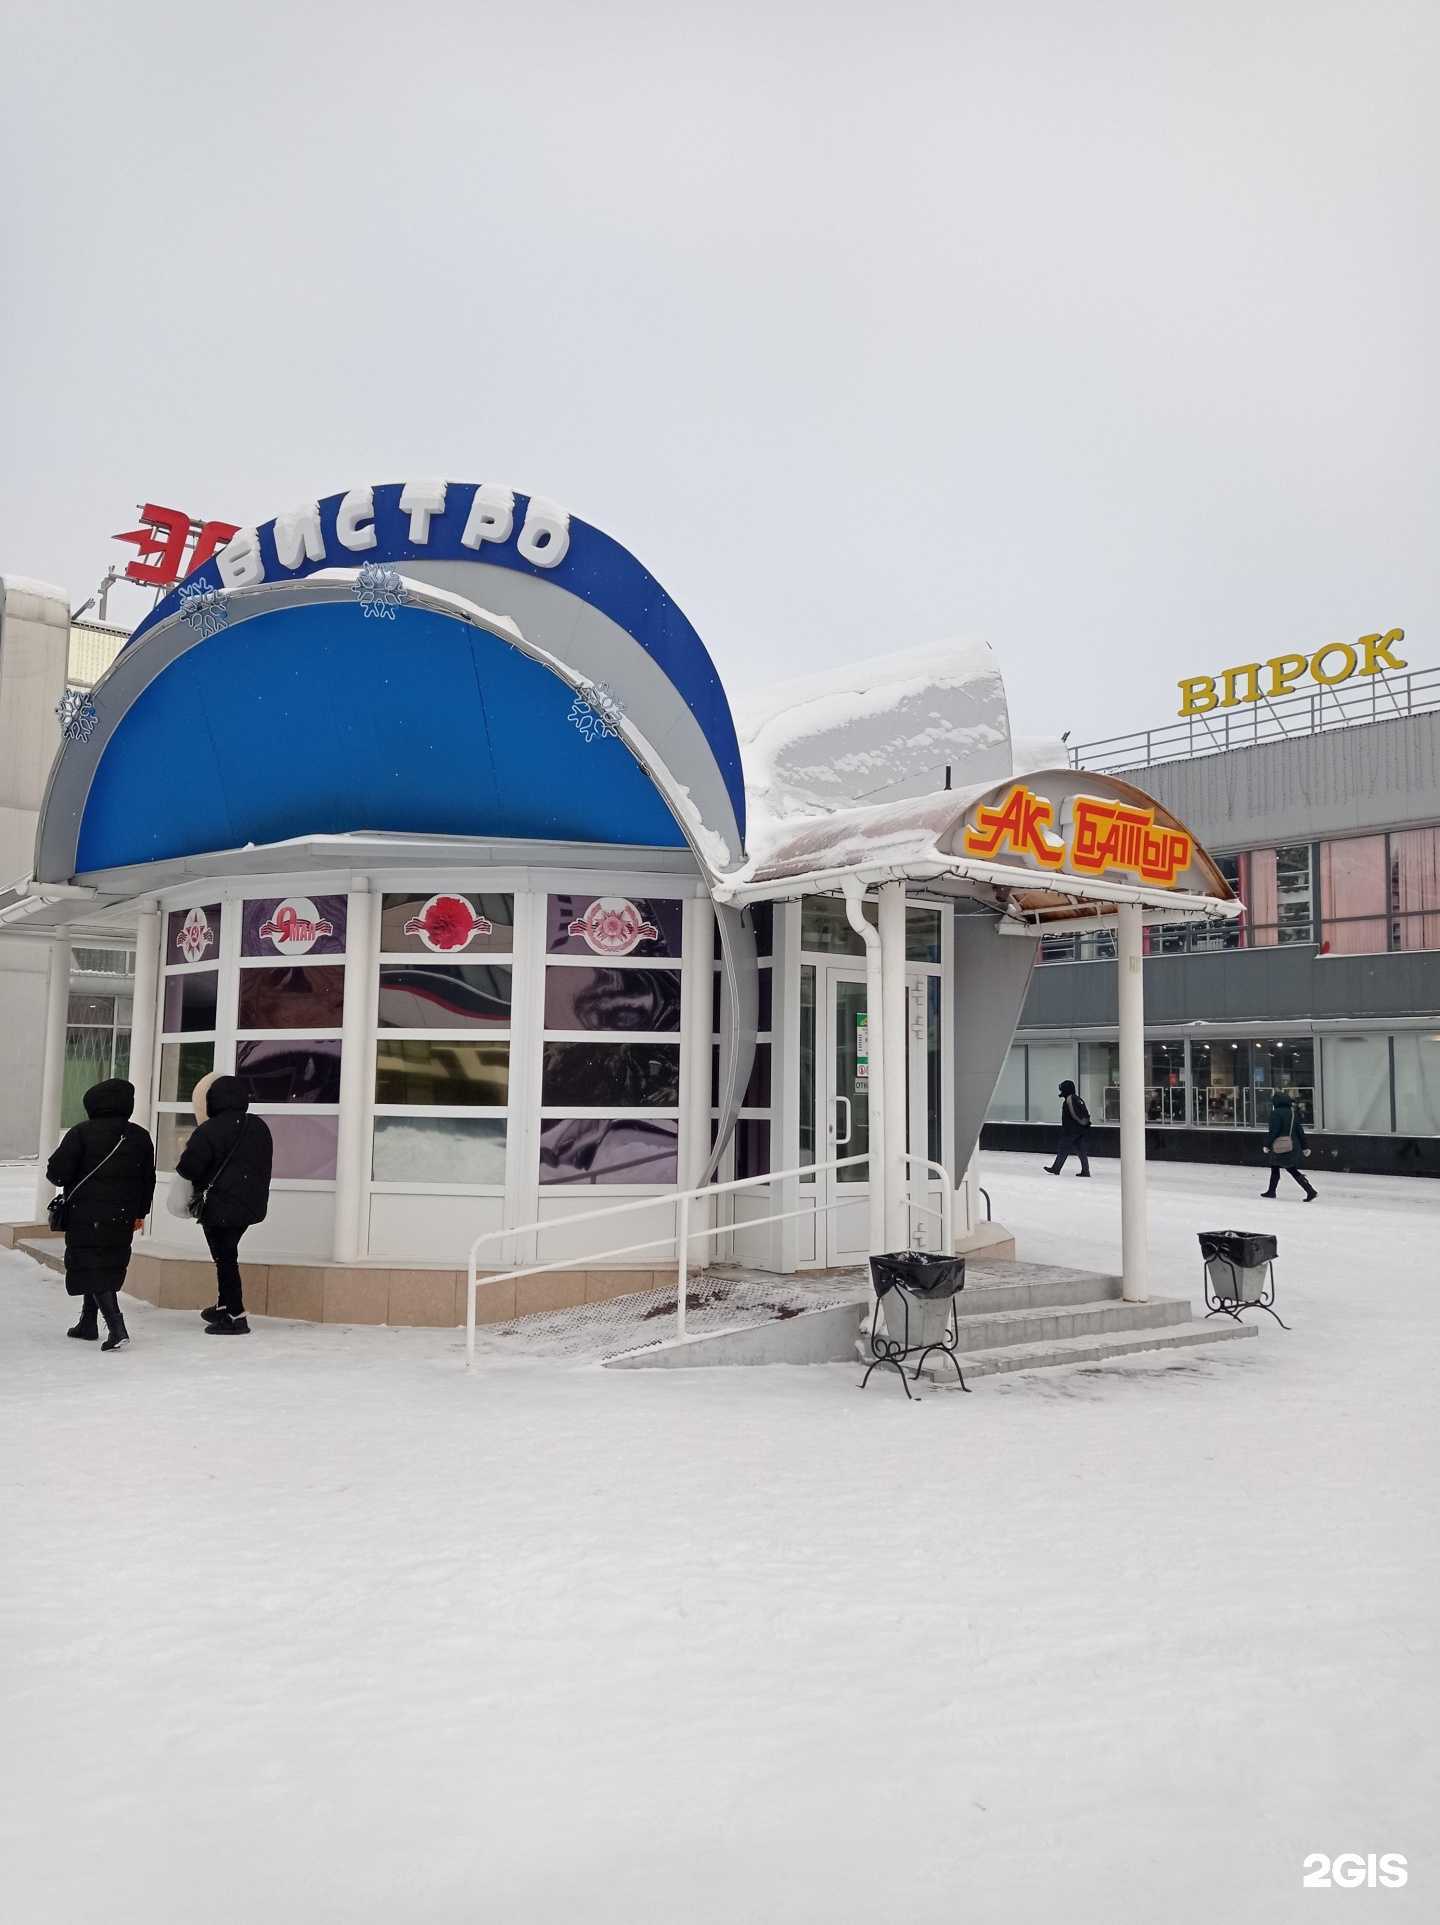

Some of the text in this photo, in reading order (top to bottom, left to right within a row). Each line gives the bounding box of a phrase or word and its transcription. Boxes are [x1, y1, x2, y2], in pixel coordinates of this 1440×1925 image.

[216, 483, 570, 588] БИСТРО
[1177, 627, 1408, 717] ВПРОК
[965, 786, 1064, 867] АК
[276, 906, 297, 943] 9
